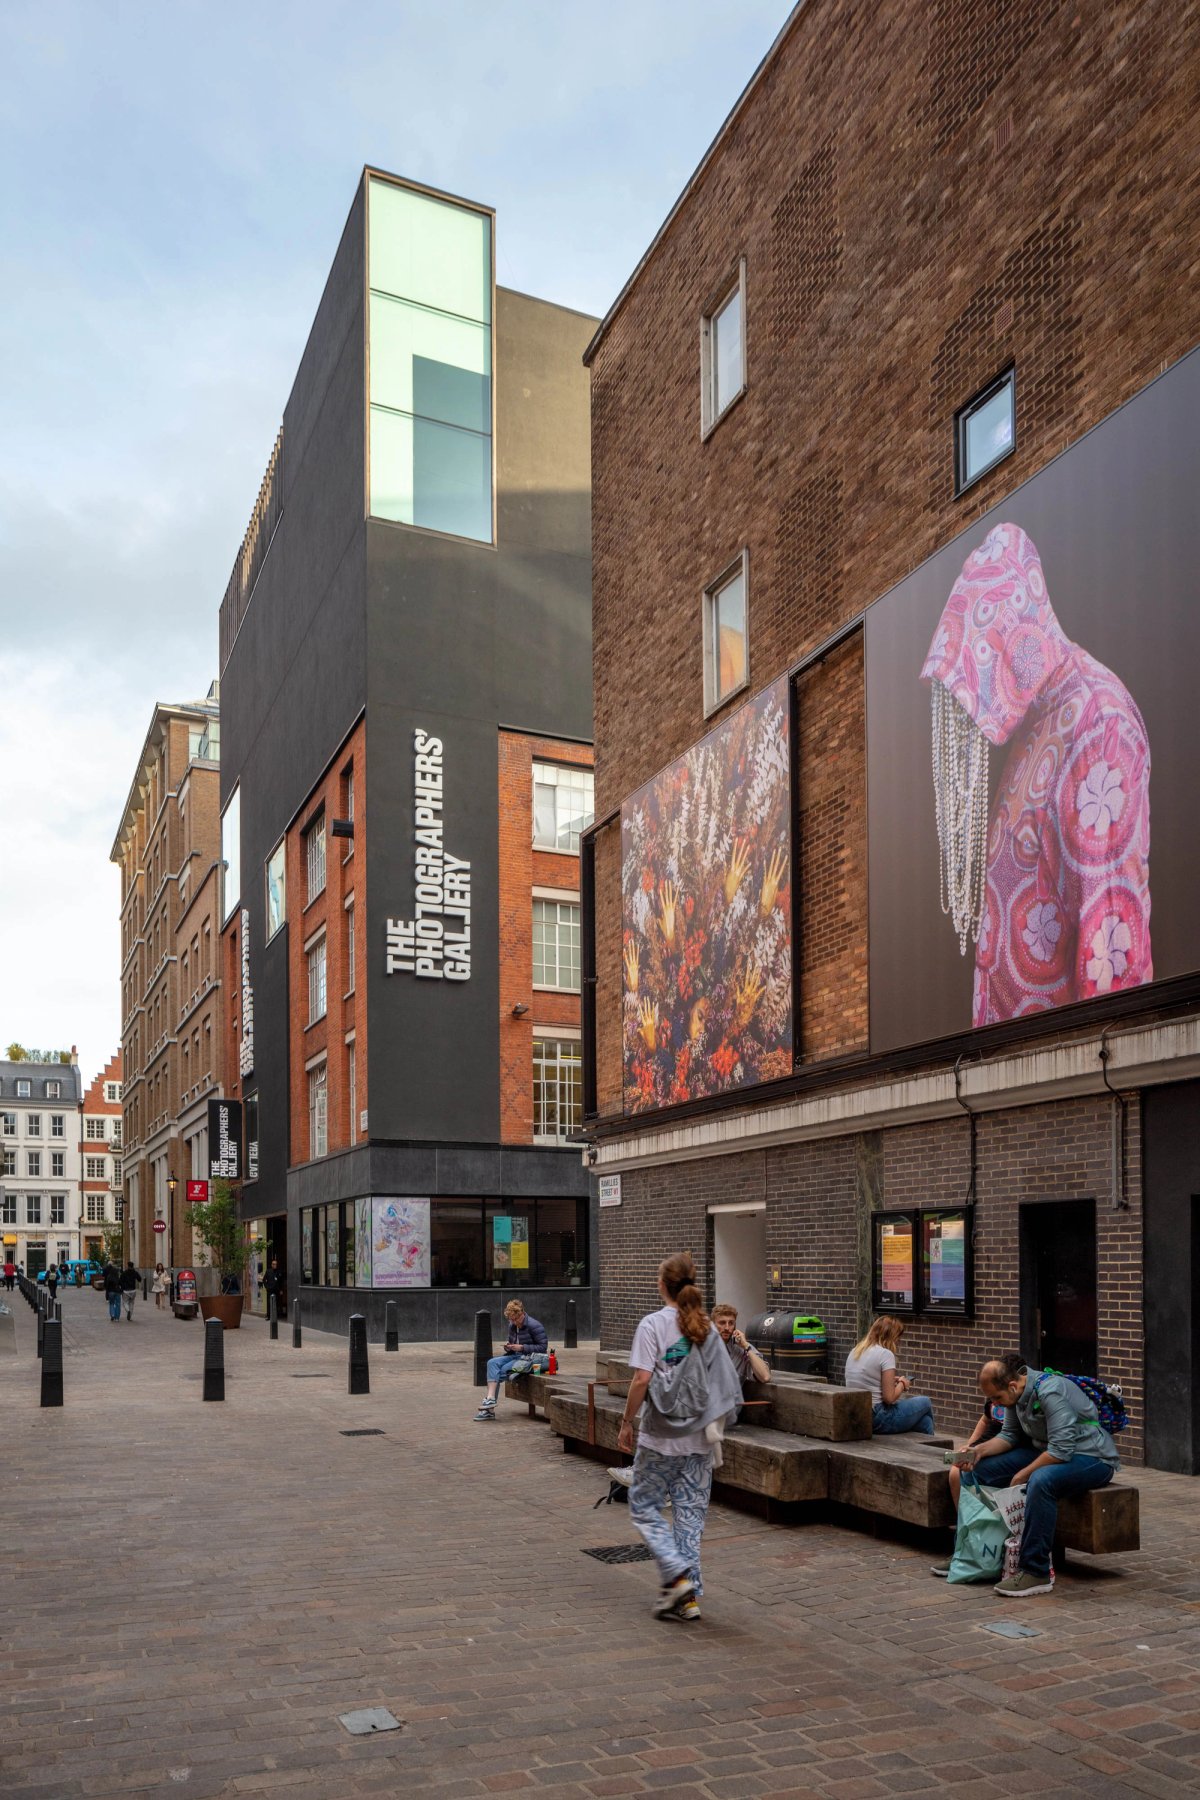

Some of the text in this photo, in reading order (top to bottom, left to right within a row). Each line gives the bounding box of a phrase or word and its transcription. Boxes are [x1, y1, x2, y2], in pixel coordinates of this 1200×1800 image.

[414, 728, 444, 980] PHOTOGRAPHERS'
[443, 852, 471, 981] GALLERY
[386, 918, 415, 975] THE
[211, 1160, 220, 1177] THE
[228, 1140, 238, 1178] GALLERY
